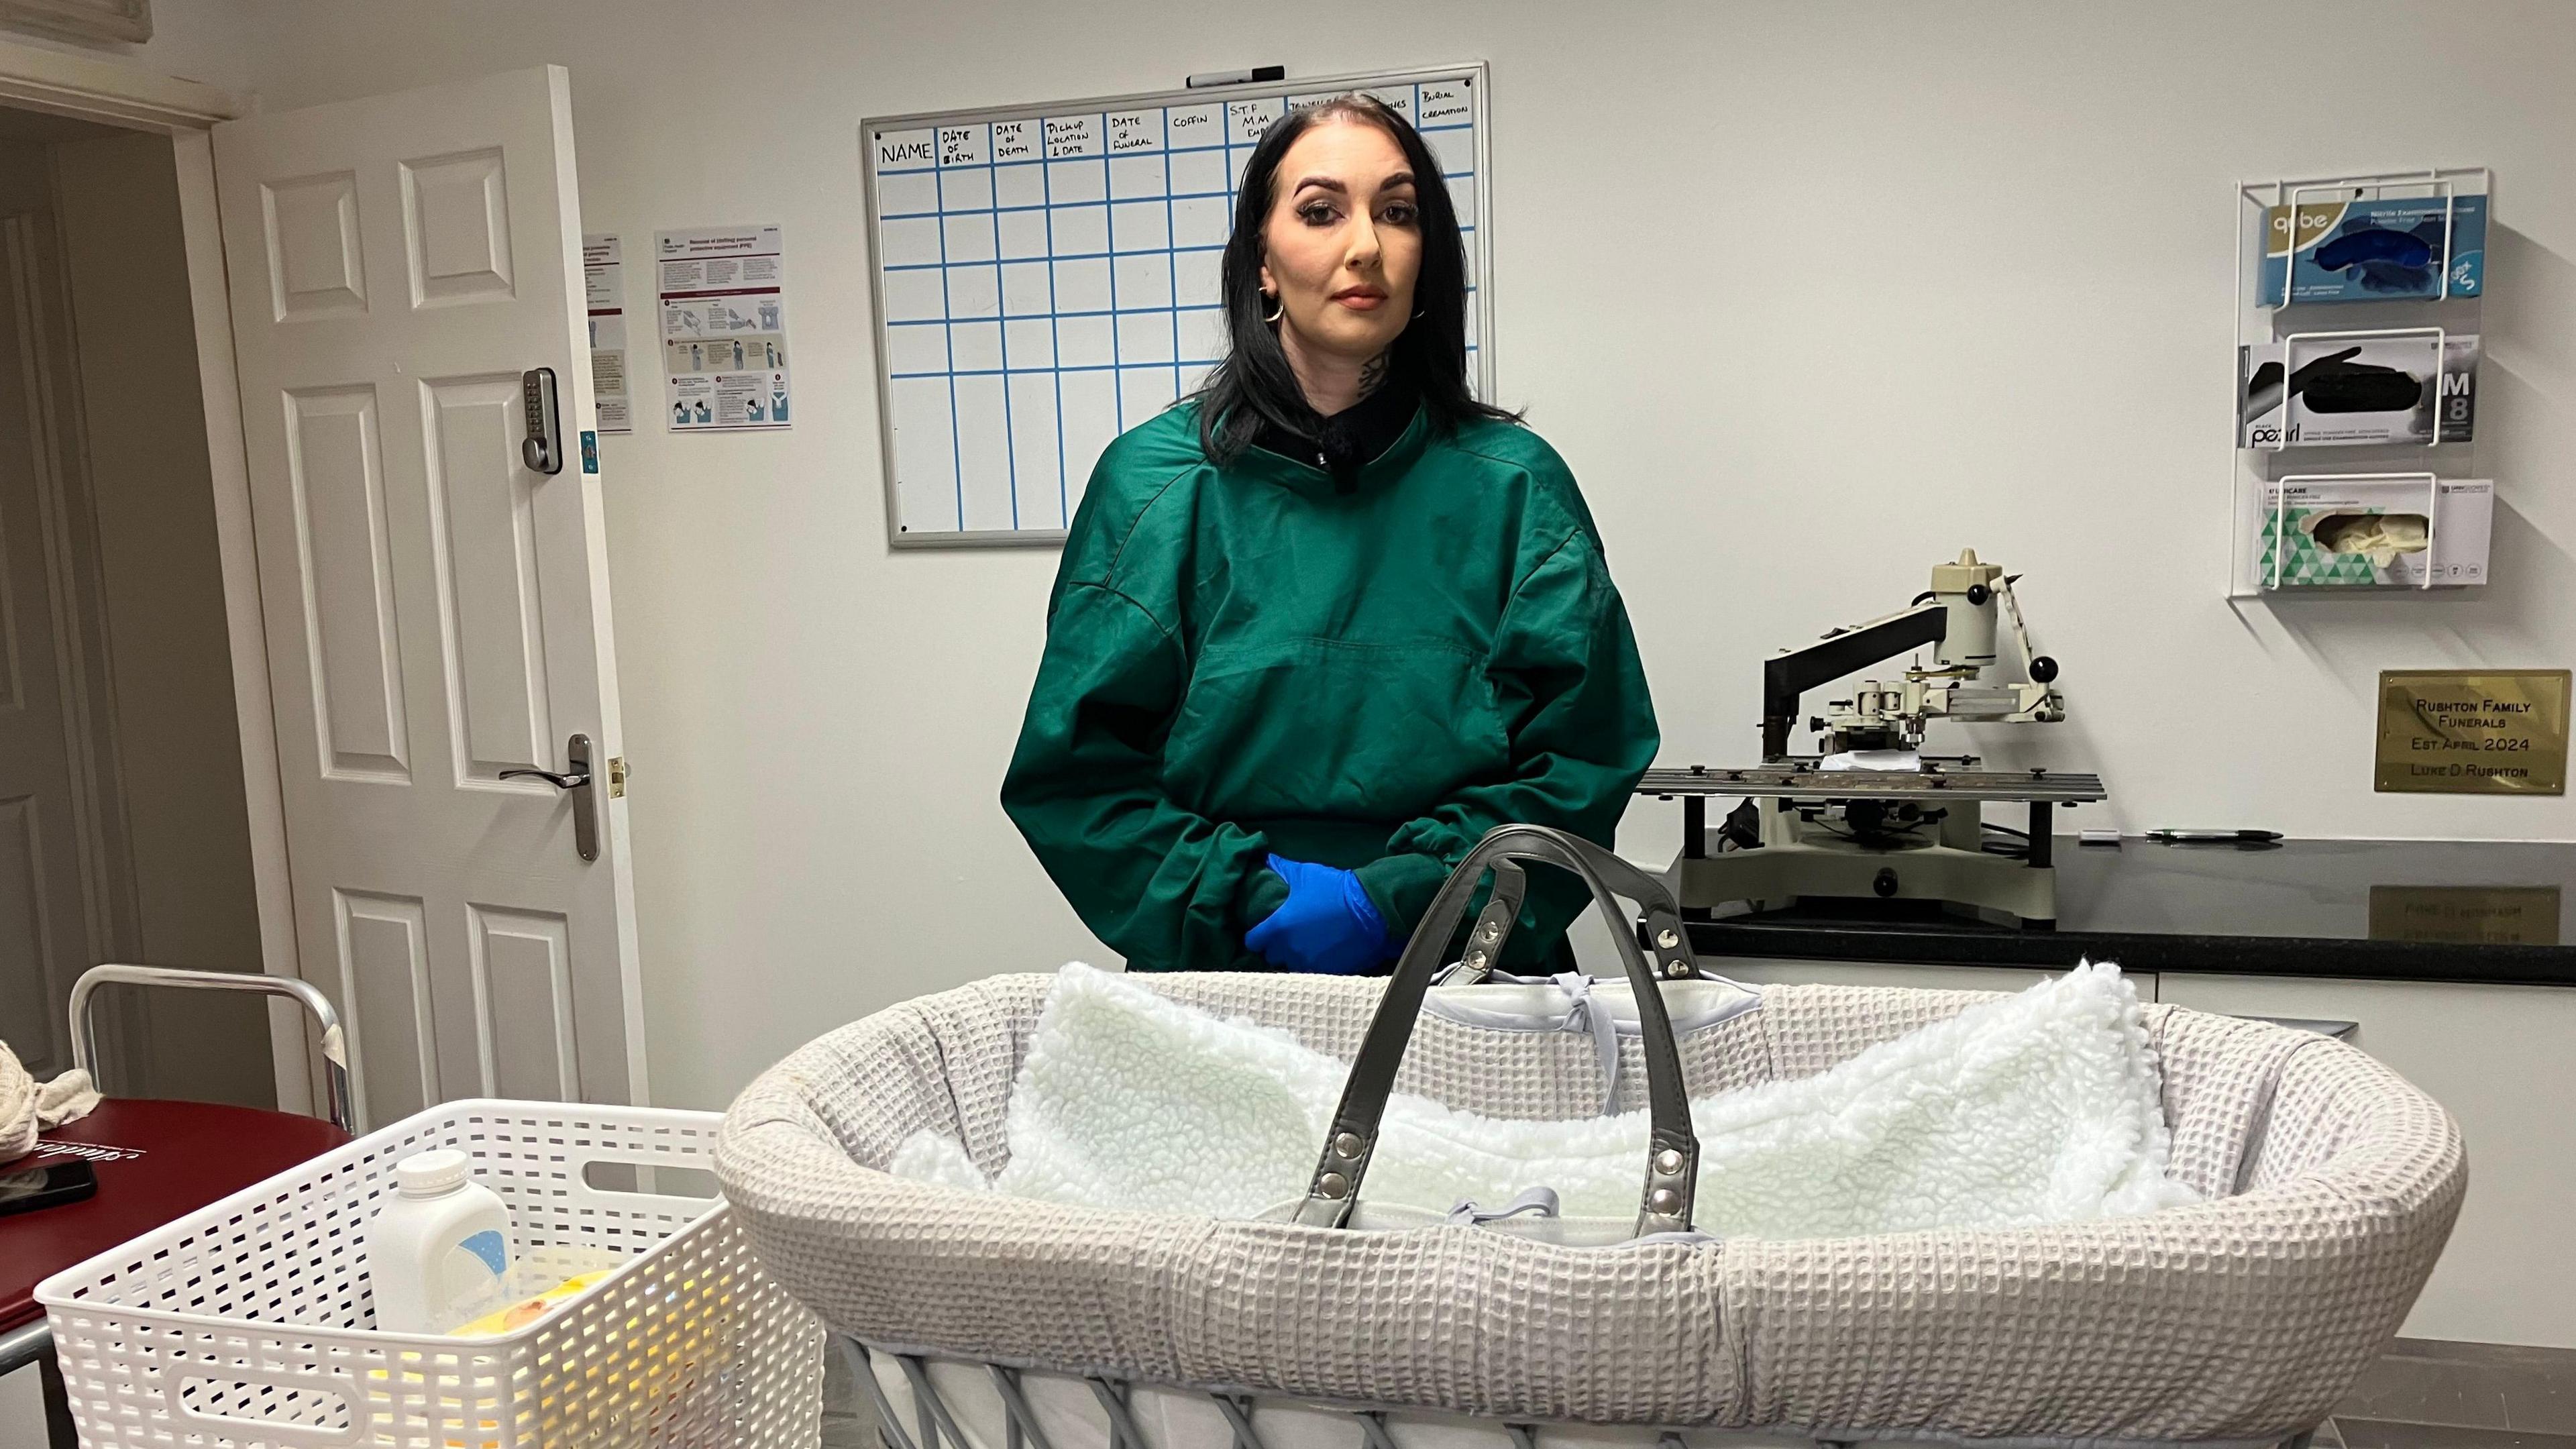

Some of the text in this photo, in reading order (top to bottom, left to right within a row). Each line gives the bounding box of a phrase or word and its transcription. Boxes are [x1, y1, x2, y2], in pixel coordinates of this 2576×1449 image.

[1422, 92, 1454, 102] BURIAL
[1422, 107, 1468, 119] CREMATION
[1112, 117, 1140, 127] DATE
[1174, 115, 1208, 127] COFFIN
[996, 123, 1022, 135] DATE
[943, 130, 970, 143] DATE
[1047, 133, 1089, 145] LOCATION
[1114, 138, 1152, 150] FUNERAL
[882, 143, 933, 163] NAME
[998, 145, 1028, 157] DEATH
[1063, 146, 1083, 155] DATE
[943, 152, 974, 164] BIRTH
[2459, 274, 2475, 290] S
[2442, 372, 2469, 396] M
[2450, 398, 2468, 420] 8
[2416, 699, 2531, 712] RUSHTON FAMILY
[2438, 716, 2506, 728] FUNERALS
[2412, 738, 2529, 751] EST APRIL 2024
[2411, 763, 2447, 776] LUKE
[2466, 764, 2528, 777] RUSHTON
